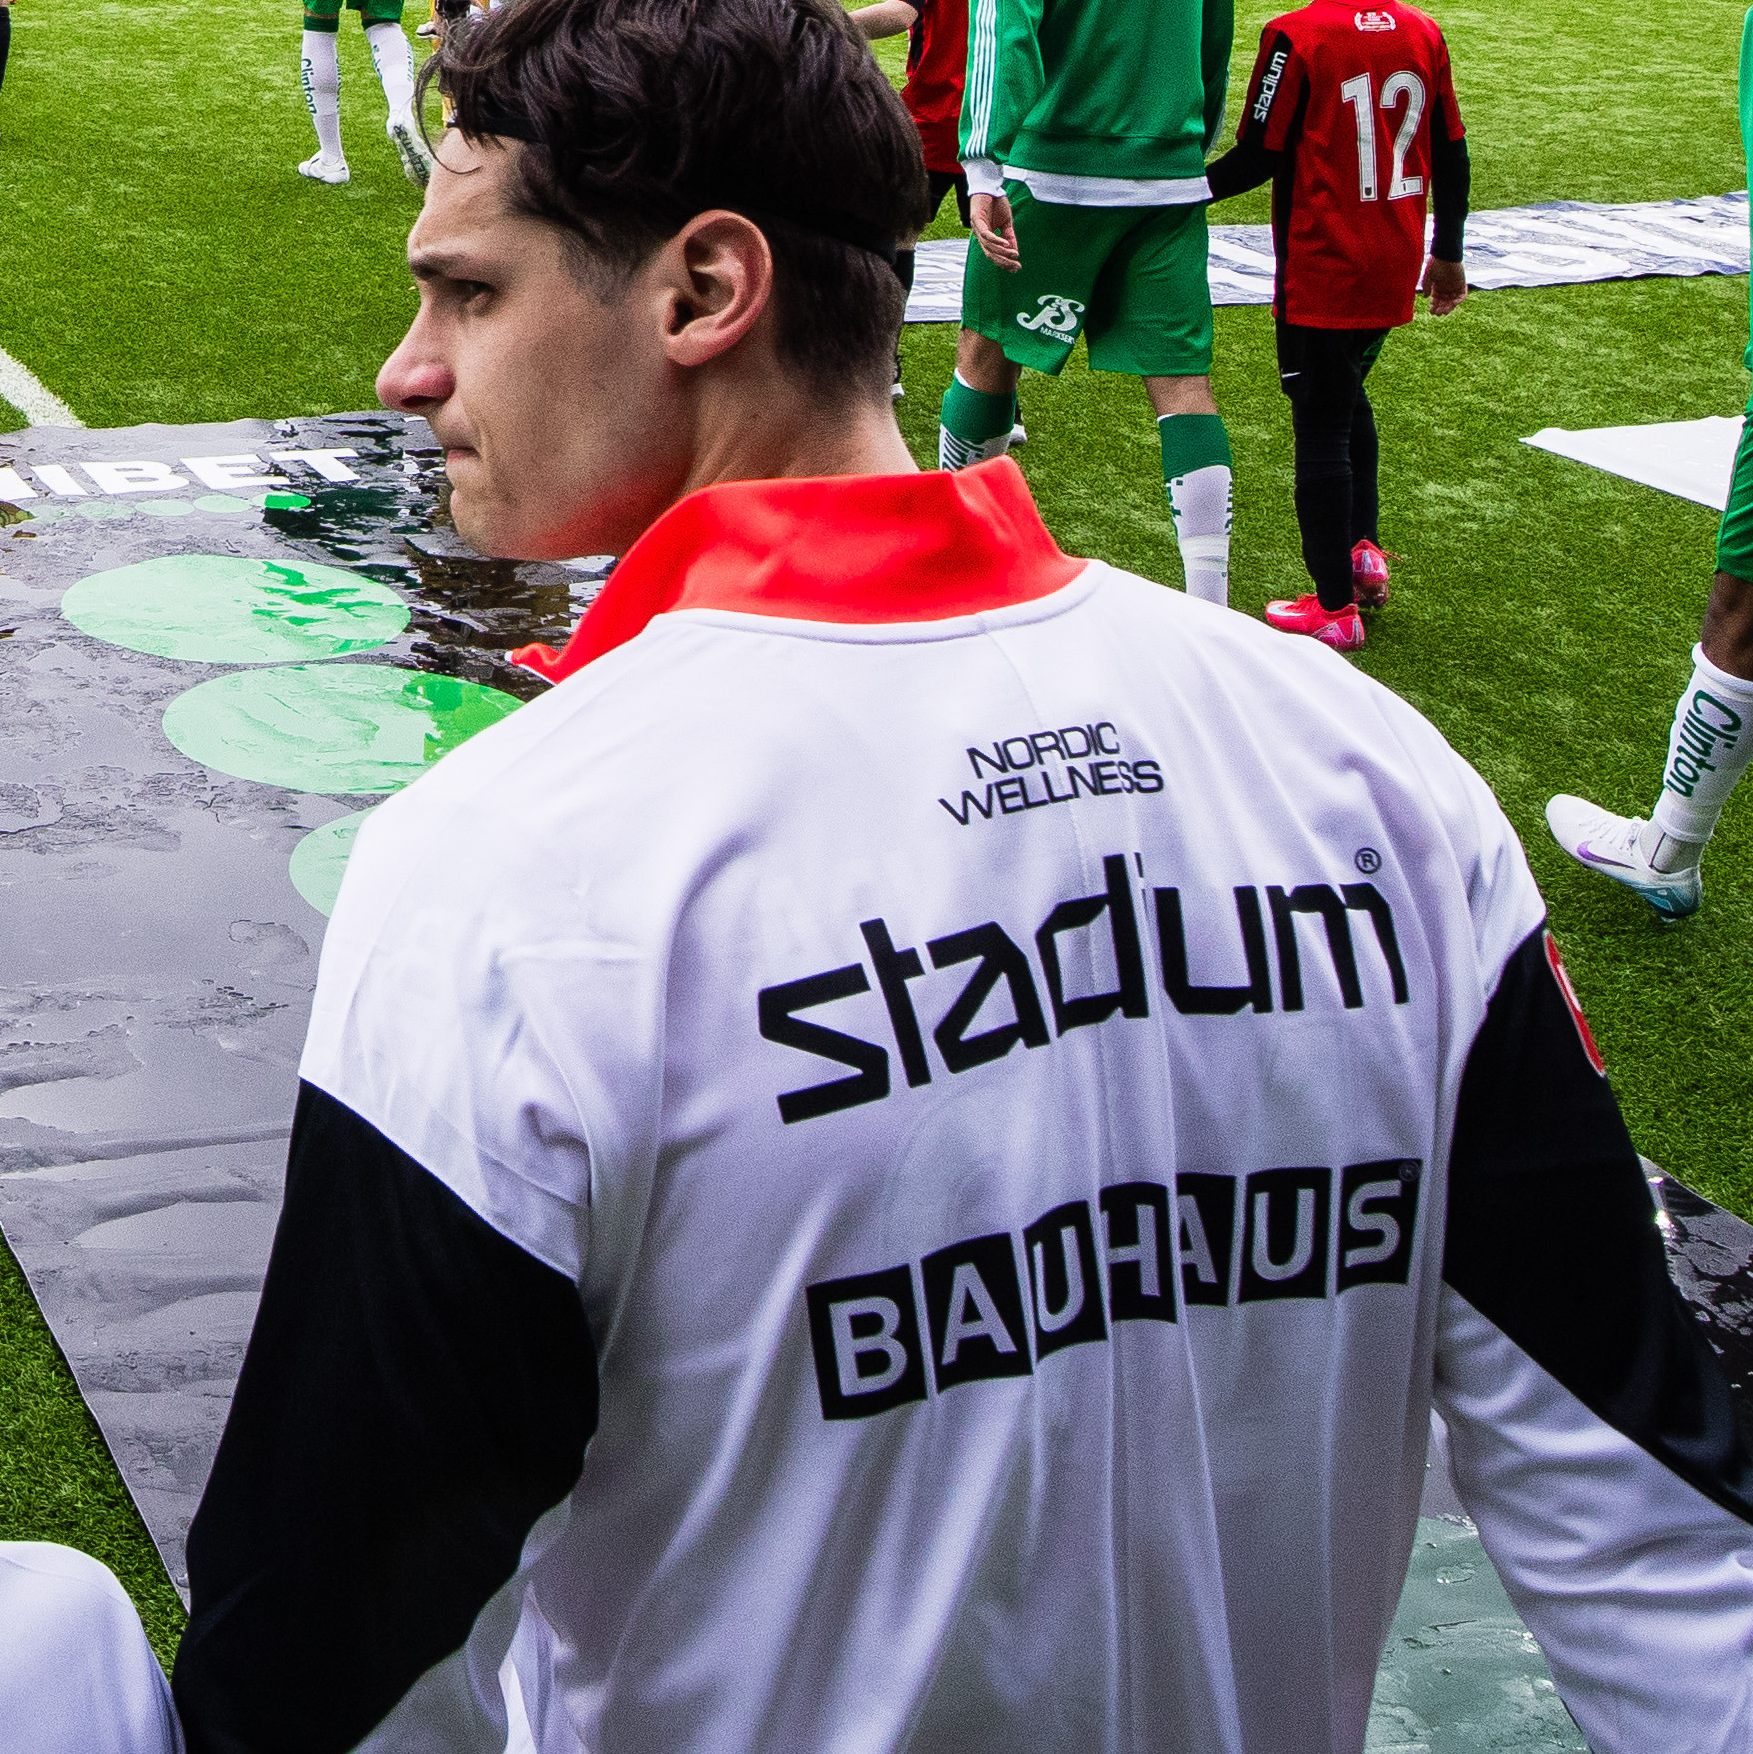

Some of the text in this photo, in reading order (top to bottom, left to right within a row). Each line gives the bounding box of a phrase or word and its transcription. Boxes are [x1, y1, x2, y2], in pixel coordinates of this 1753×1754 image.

[1253, 51, 1288, 123] stadium
[1341, 70, 1425, 202] 12
[967, 720, 1120, 780] NORDIC
[1666, 690, 1743, 800] Clinton
[938, 759, 1165, 826] WELLNESS
[813, 1161, 1415, 1414] BAUHAUS
